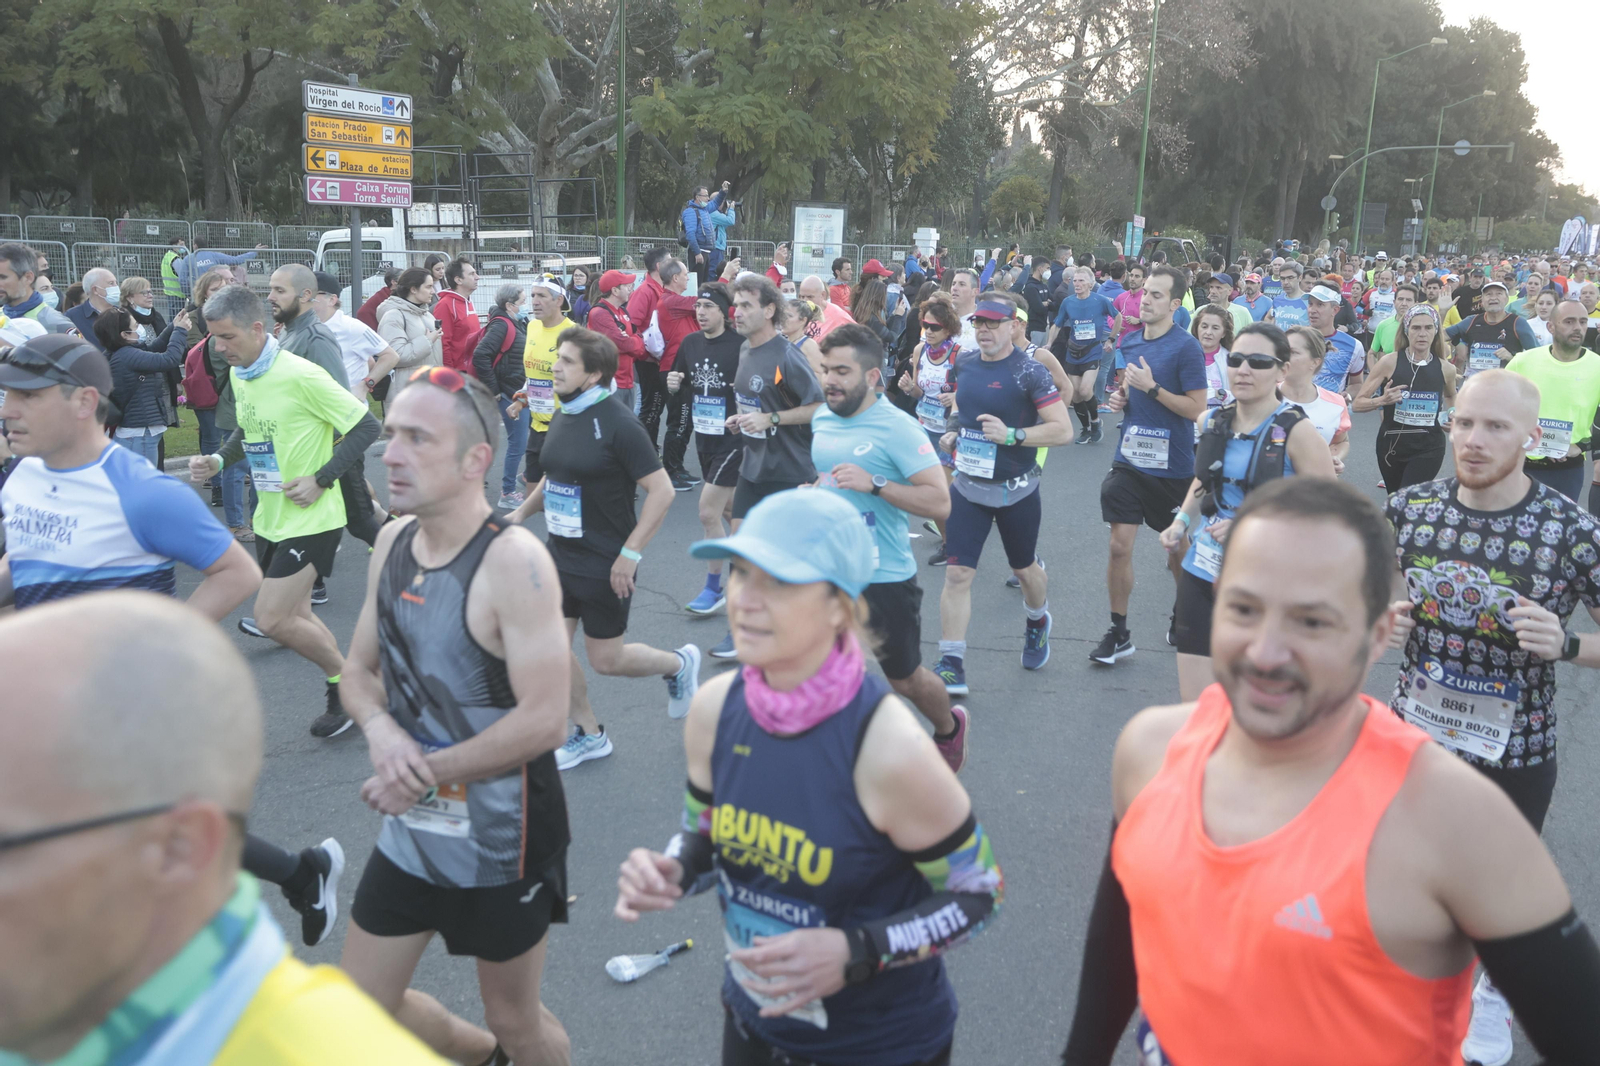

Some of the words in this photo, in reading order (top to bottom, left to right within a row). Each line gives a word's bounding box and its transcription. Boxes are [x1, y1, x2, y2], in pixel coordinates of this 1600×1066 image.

[309, 86, 338, 97] hospital
[309, 95, 338, 109] Virgen
[341, 99, 355, 110] del
[343, 121, 367, 132] Prado
[310, 128, 327, 138] San
[331, 130, 374, 143] Sebastián
[340, 161, 363, 172] Plaza
[368, 164, 378, 173] de
[382, 164, 409, 175] Armas
[355, 182, 380, 193] Caixa
[383, 183, 409, 194] Forum
[353, 192, 377, 203] Torre
[380, 194, 409, 205] Sevilla
[124, 255, 136, 263] AMS
[249, 261, 262, 269] AMS
[378, 261, 391, 269] AMS
[503, 265, 514, 273] AMS
[524, 360, 553, 373] SEVILLA
[699, 397, 721, 405] ZURICH
[1395, 410, 1415, 418] GOLDEN
[1540, 419, 1568, 429] ZURICH
[1138, 427, 1165, 437] ZURICH
[1136, 441, 1153, 449] 9033
[549, 483, 575, 496] ZURICH
[14, 503, 63, 526] RUNNERS
[64, 515, 79, 530] LA
[9, 516, 72, 546] PALMERA
[1444, 673, 1507, 696] ZURICH
[1440, 697, 1475, 715] 8861
[1413, 703, 1463, 728] RICHARD
[1465, 721, 1500, 739] 80/20
[737, 885, 811, 926] ZURICH
